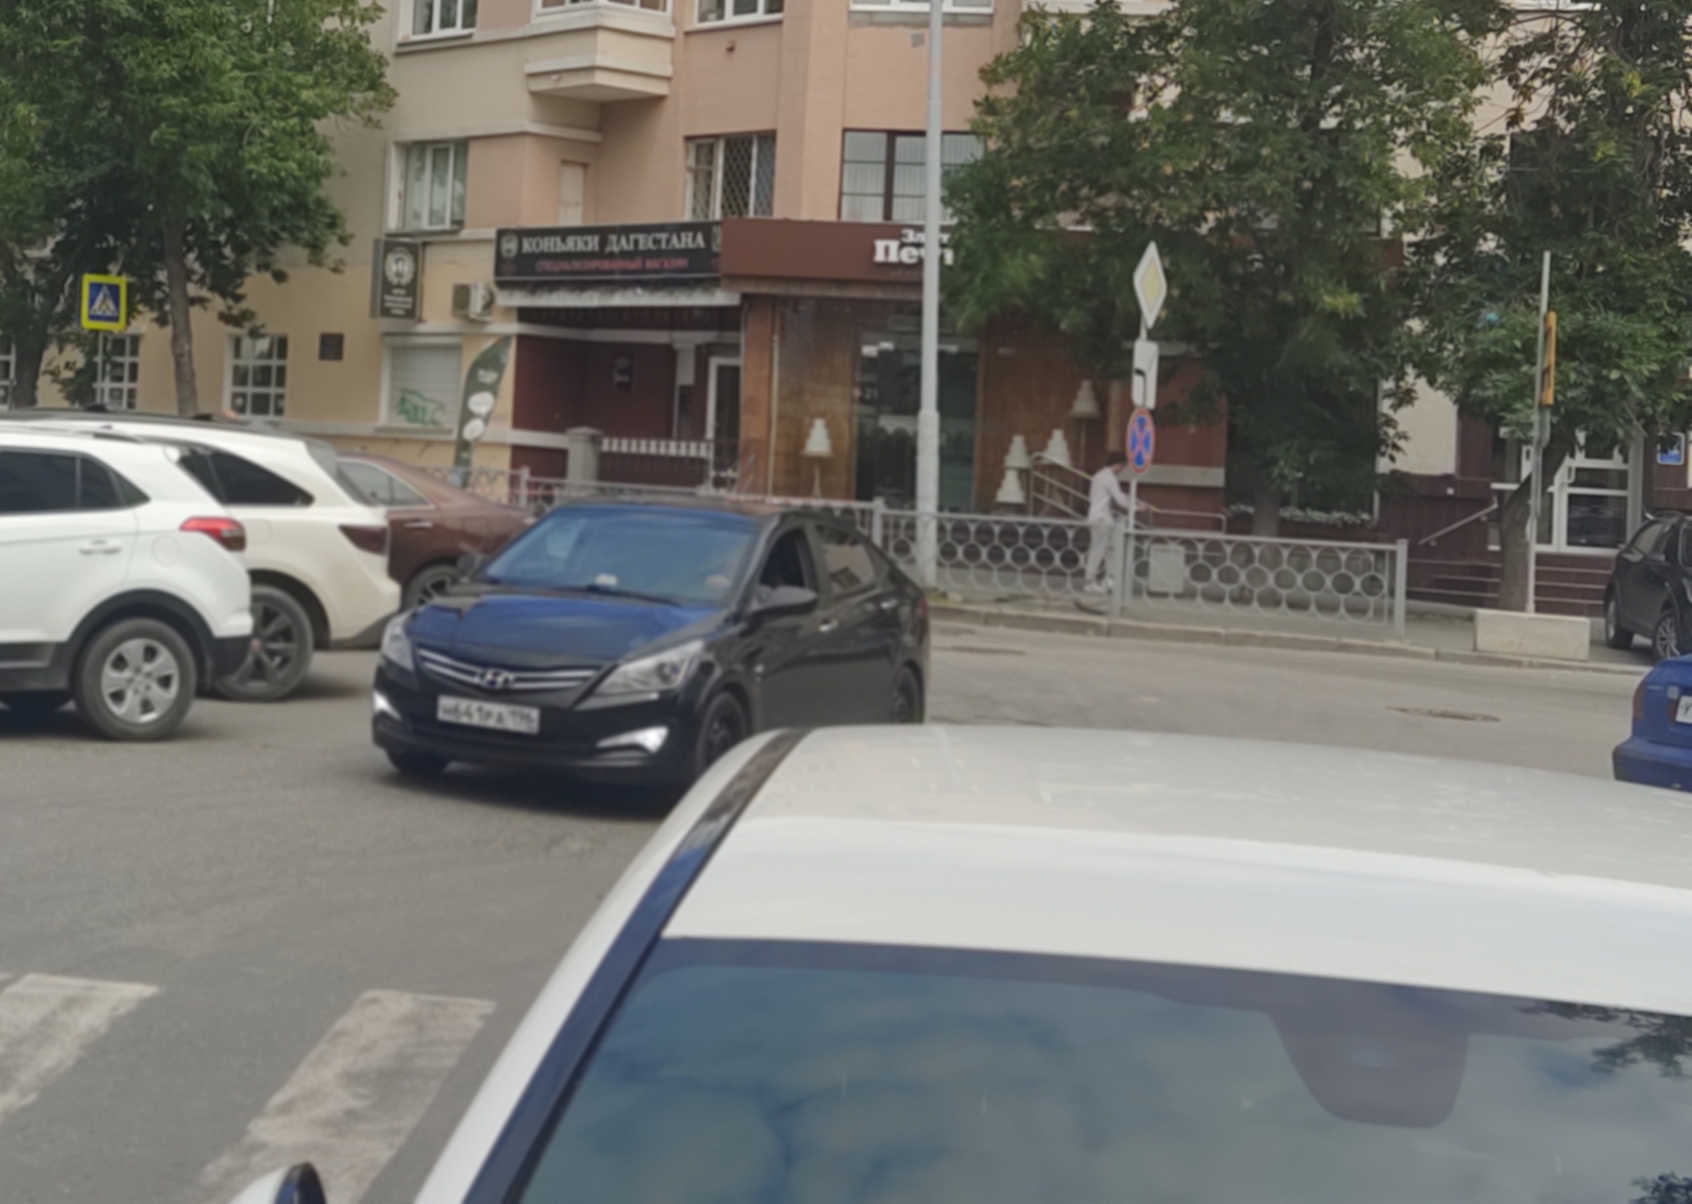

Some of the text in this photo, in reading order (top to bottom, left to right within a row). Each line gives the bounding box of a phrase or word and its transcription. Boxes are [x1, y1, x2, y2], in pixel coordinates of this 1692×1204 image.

[521, 231, 706, 255] КОНЬЯКИ ДАГЕСТАНА
[645, 256, 689, 270] МАГАЗИН
